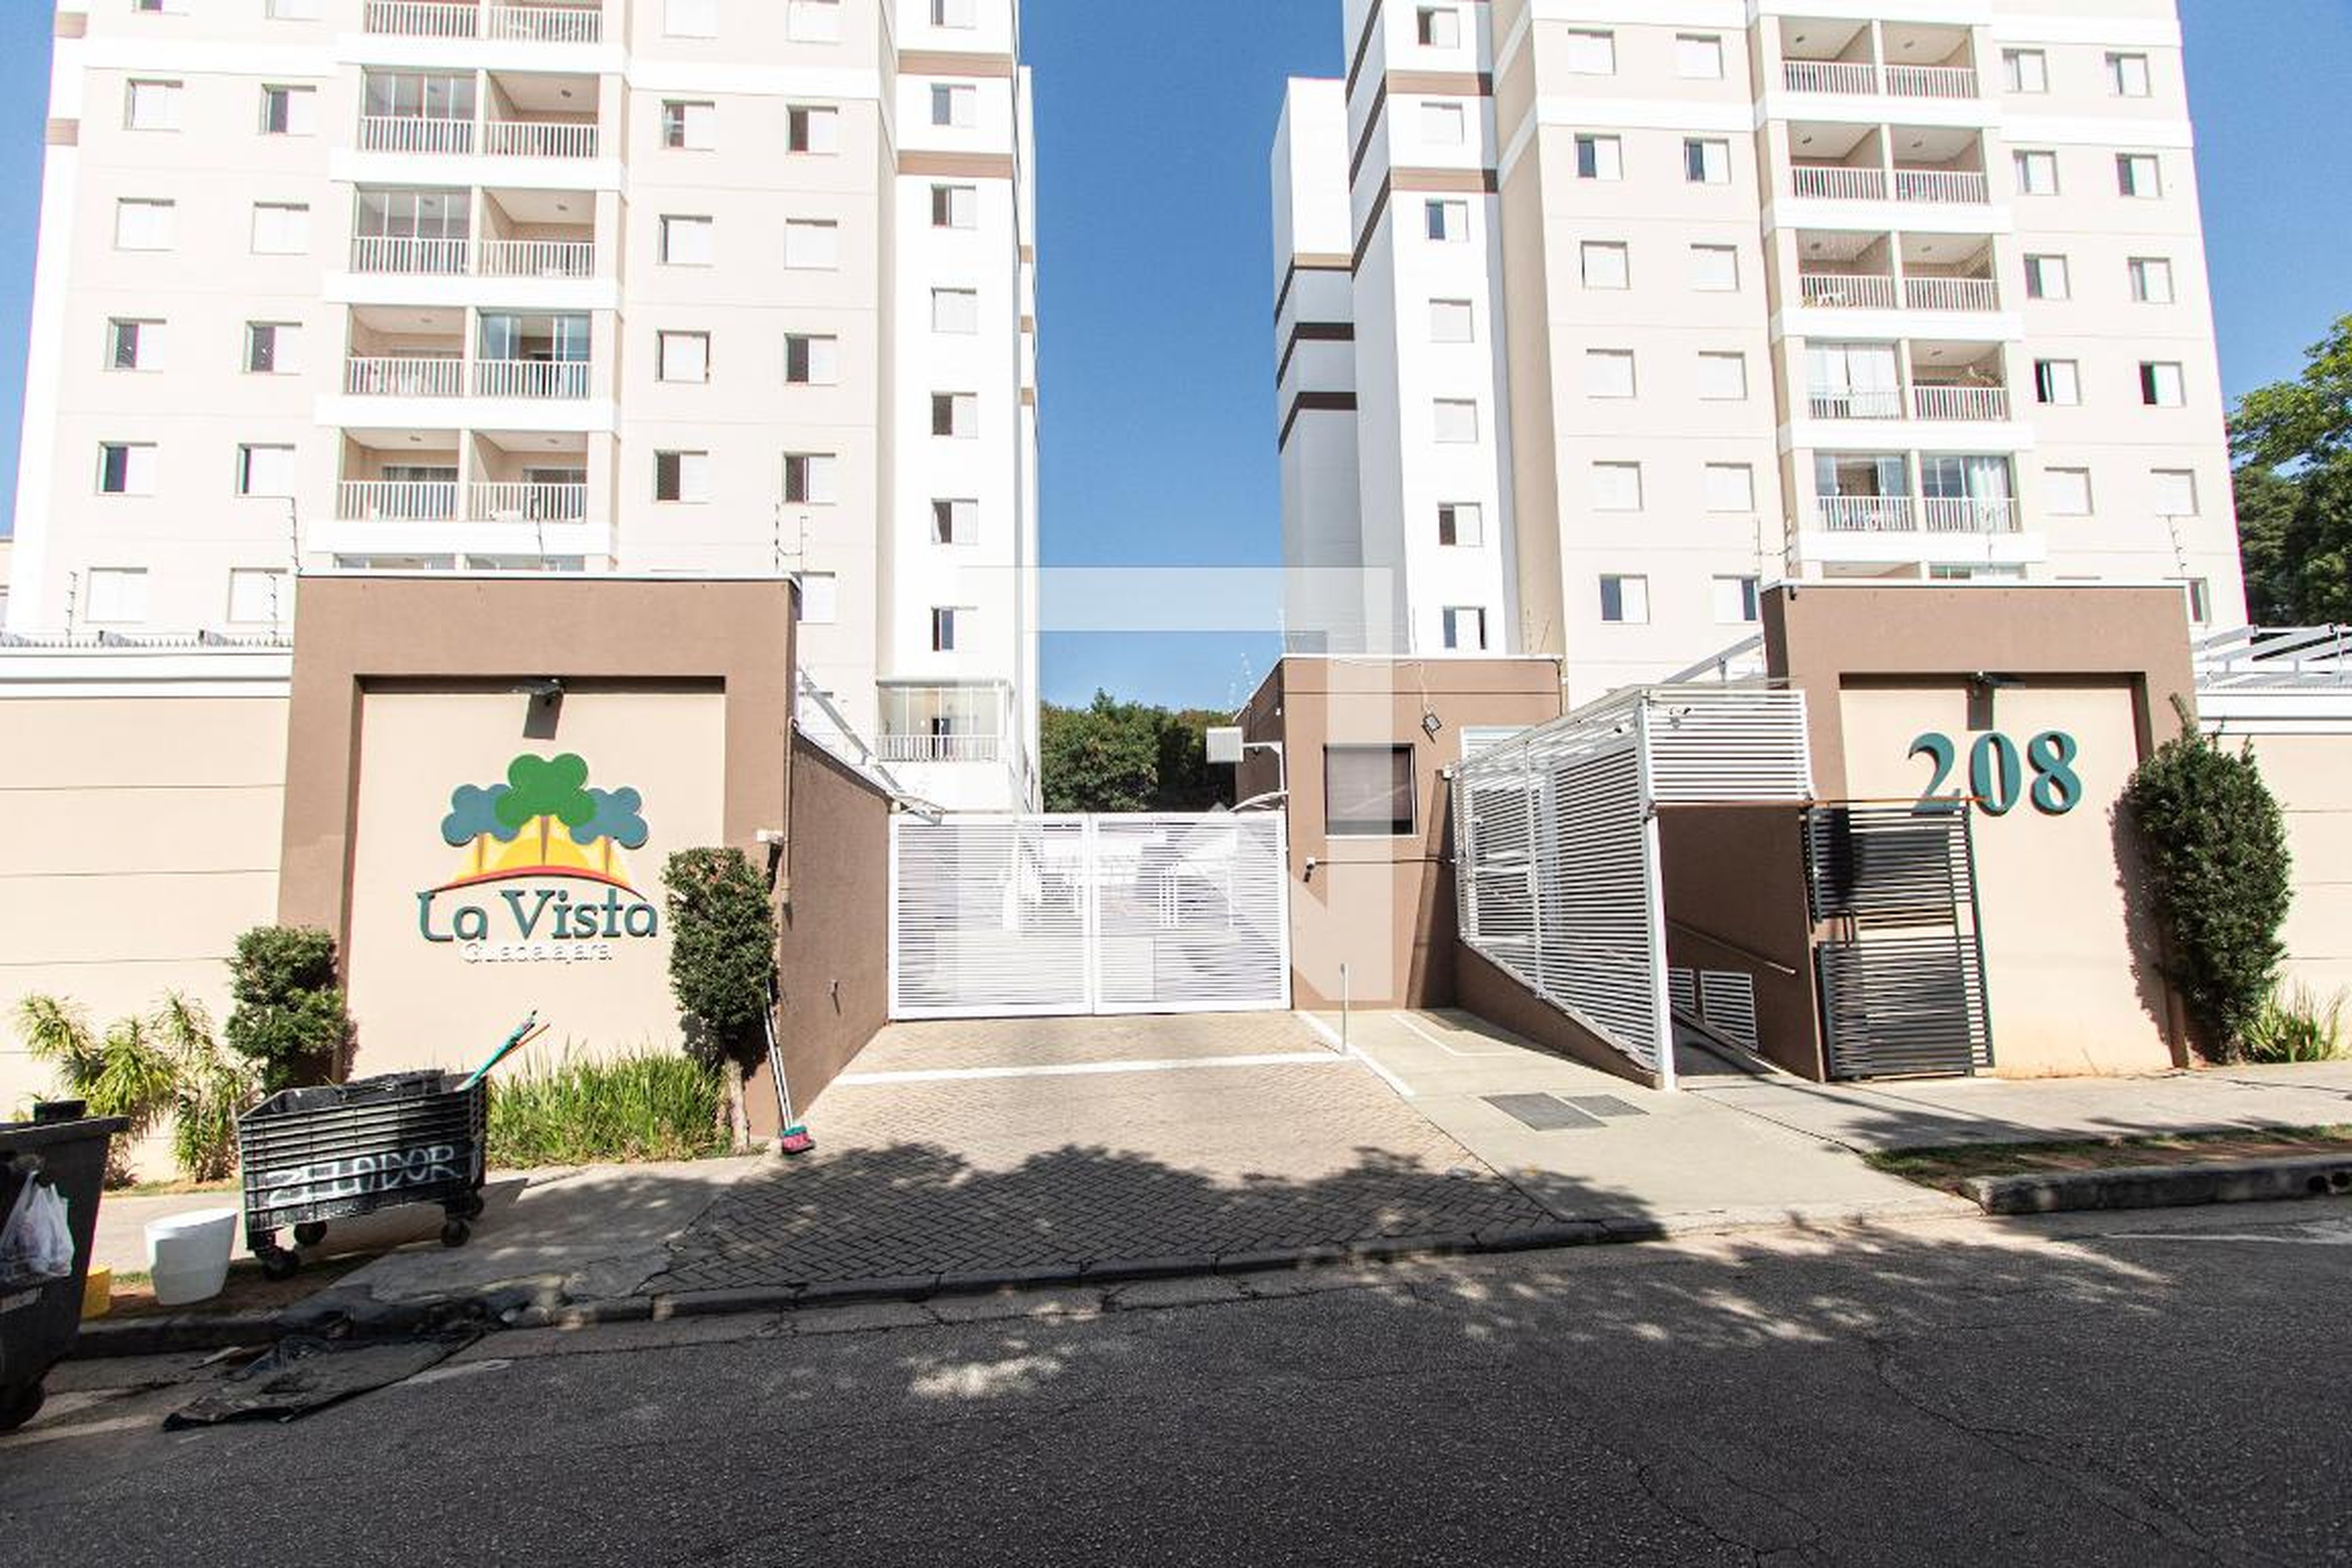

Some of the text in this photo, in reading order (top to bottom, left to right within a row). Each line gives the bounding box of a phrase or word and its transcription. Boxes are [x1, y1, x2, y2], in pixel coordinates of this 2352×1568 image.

[1908, 731, 2082, 816] 208
[417, 888, 658, 942] La Vista
